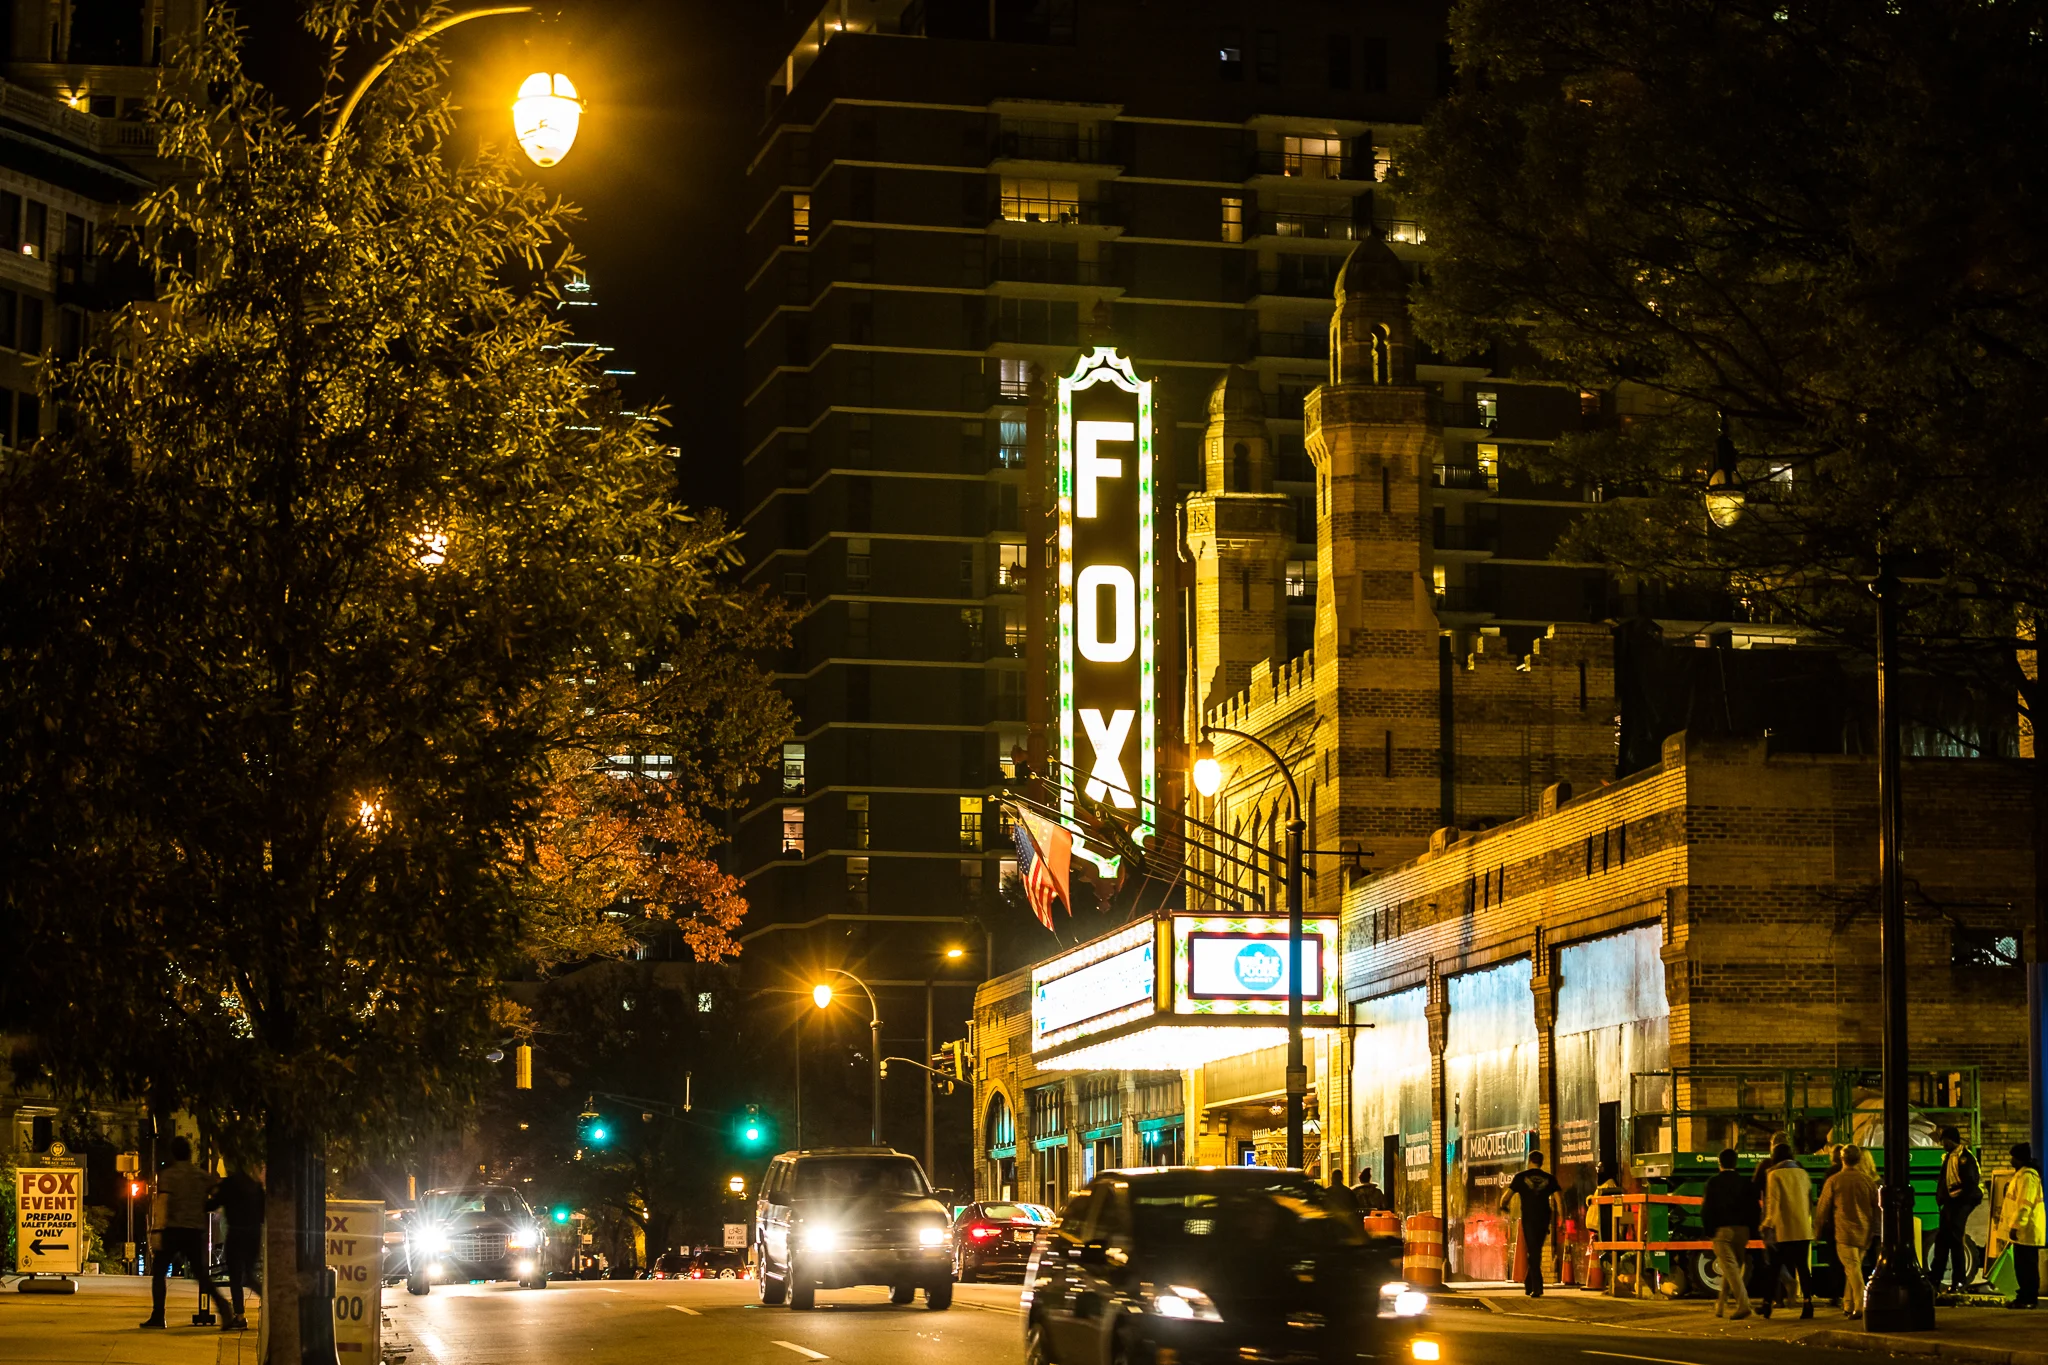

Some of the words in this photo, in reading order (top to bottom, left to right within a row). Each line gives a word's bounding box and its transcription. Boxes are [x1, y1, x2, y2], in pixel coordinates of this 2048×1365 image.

[1075, 420, 1137, 810] FOX
[1470, 1134, 1506, 1159] MARQUEE
[1506, 1131, 1525, 1154] CLUB
[22, 1174, 75, 1195] FOX
[20, 1196, 77, 1210] EVENT
[26, 1213, 72, 1221] PREPAID
[35, 1229, 64, 1237] ONLY
[336, 1295, 363, 1321] 00
